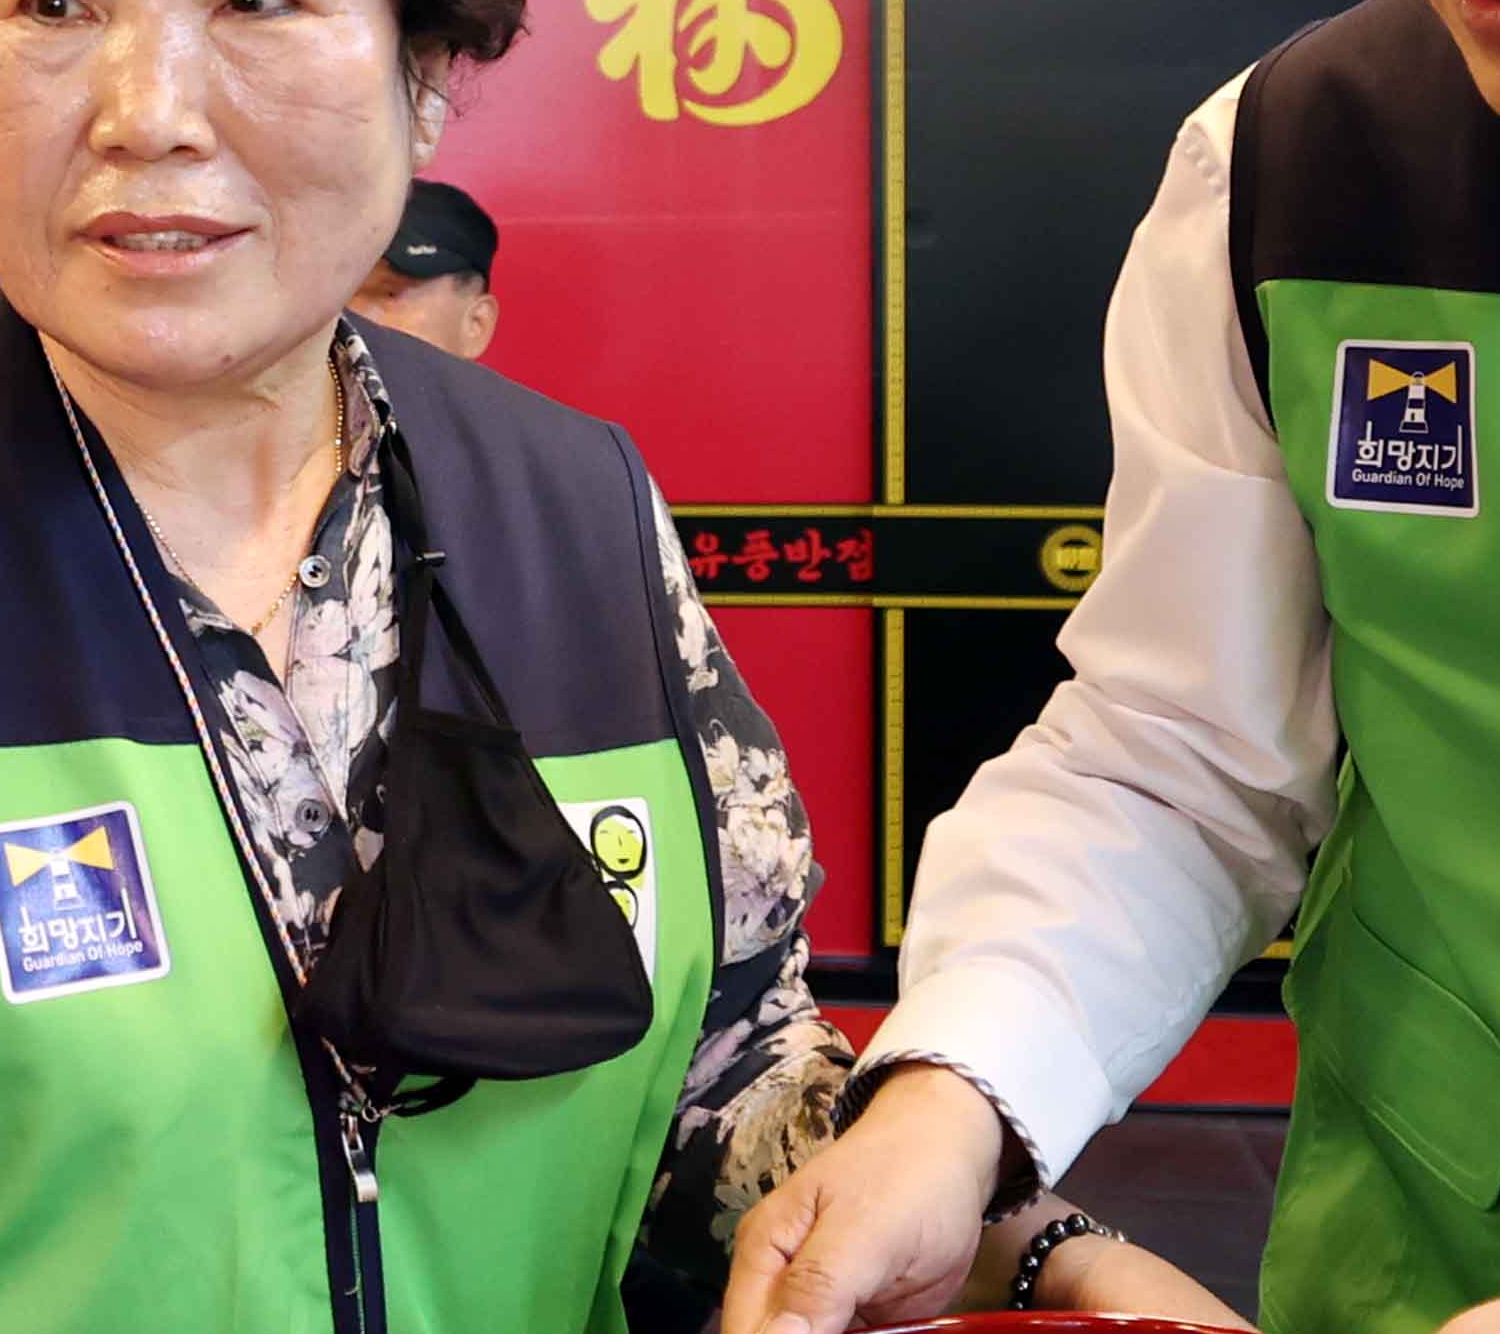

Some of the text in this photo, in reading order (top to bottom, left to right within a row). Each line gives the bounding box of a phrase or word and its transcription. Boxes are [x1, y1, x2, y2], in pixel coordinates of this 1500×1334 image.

[1354, 420, 1463, 476] 희망지기
[1352, 468, 1465, 491] Guardian Of Hope
[688, 527, 874, 583] 유풍반점
[18, 887, 137, 954] 희망지기
[23, 941, 143, 972] Guardian Of Hope
